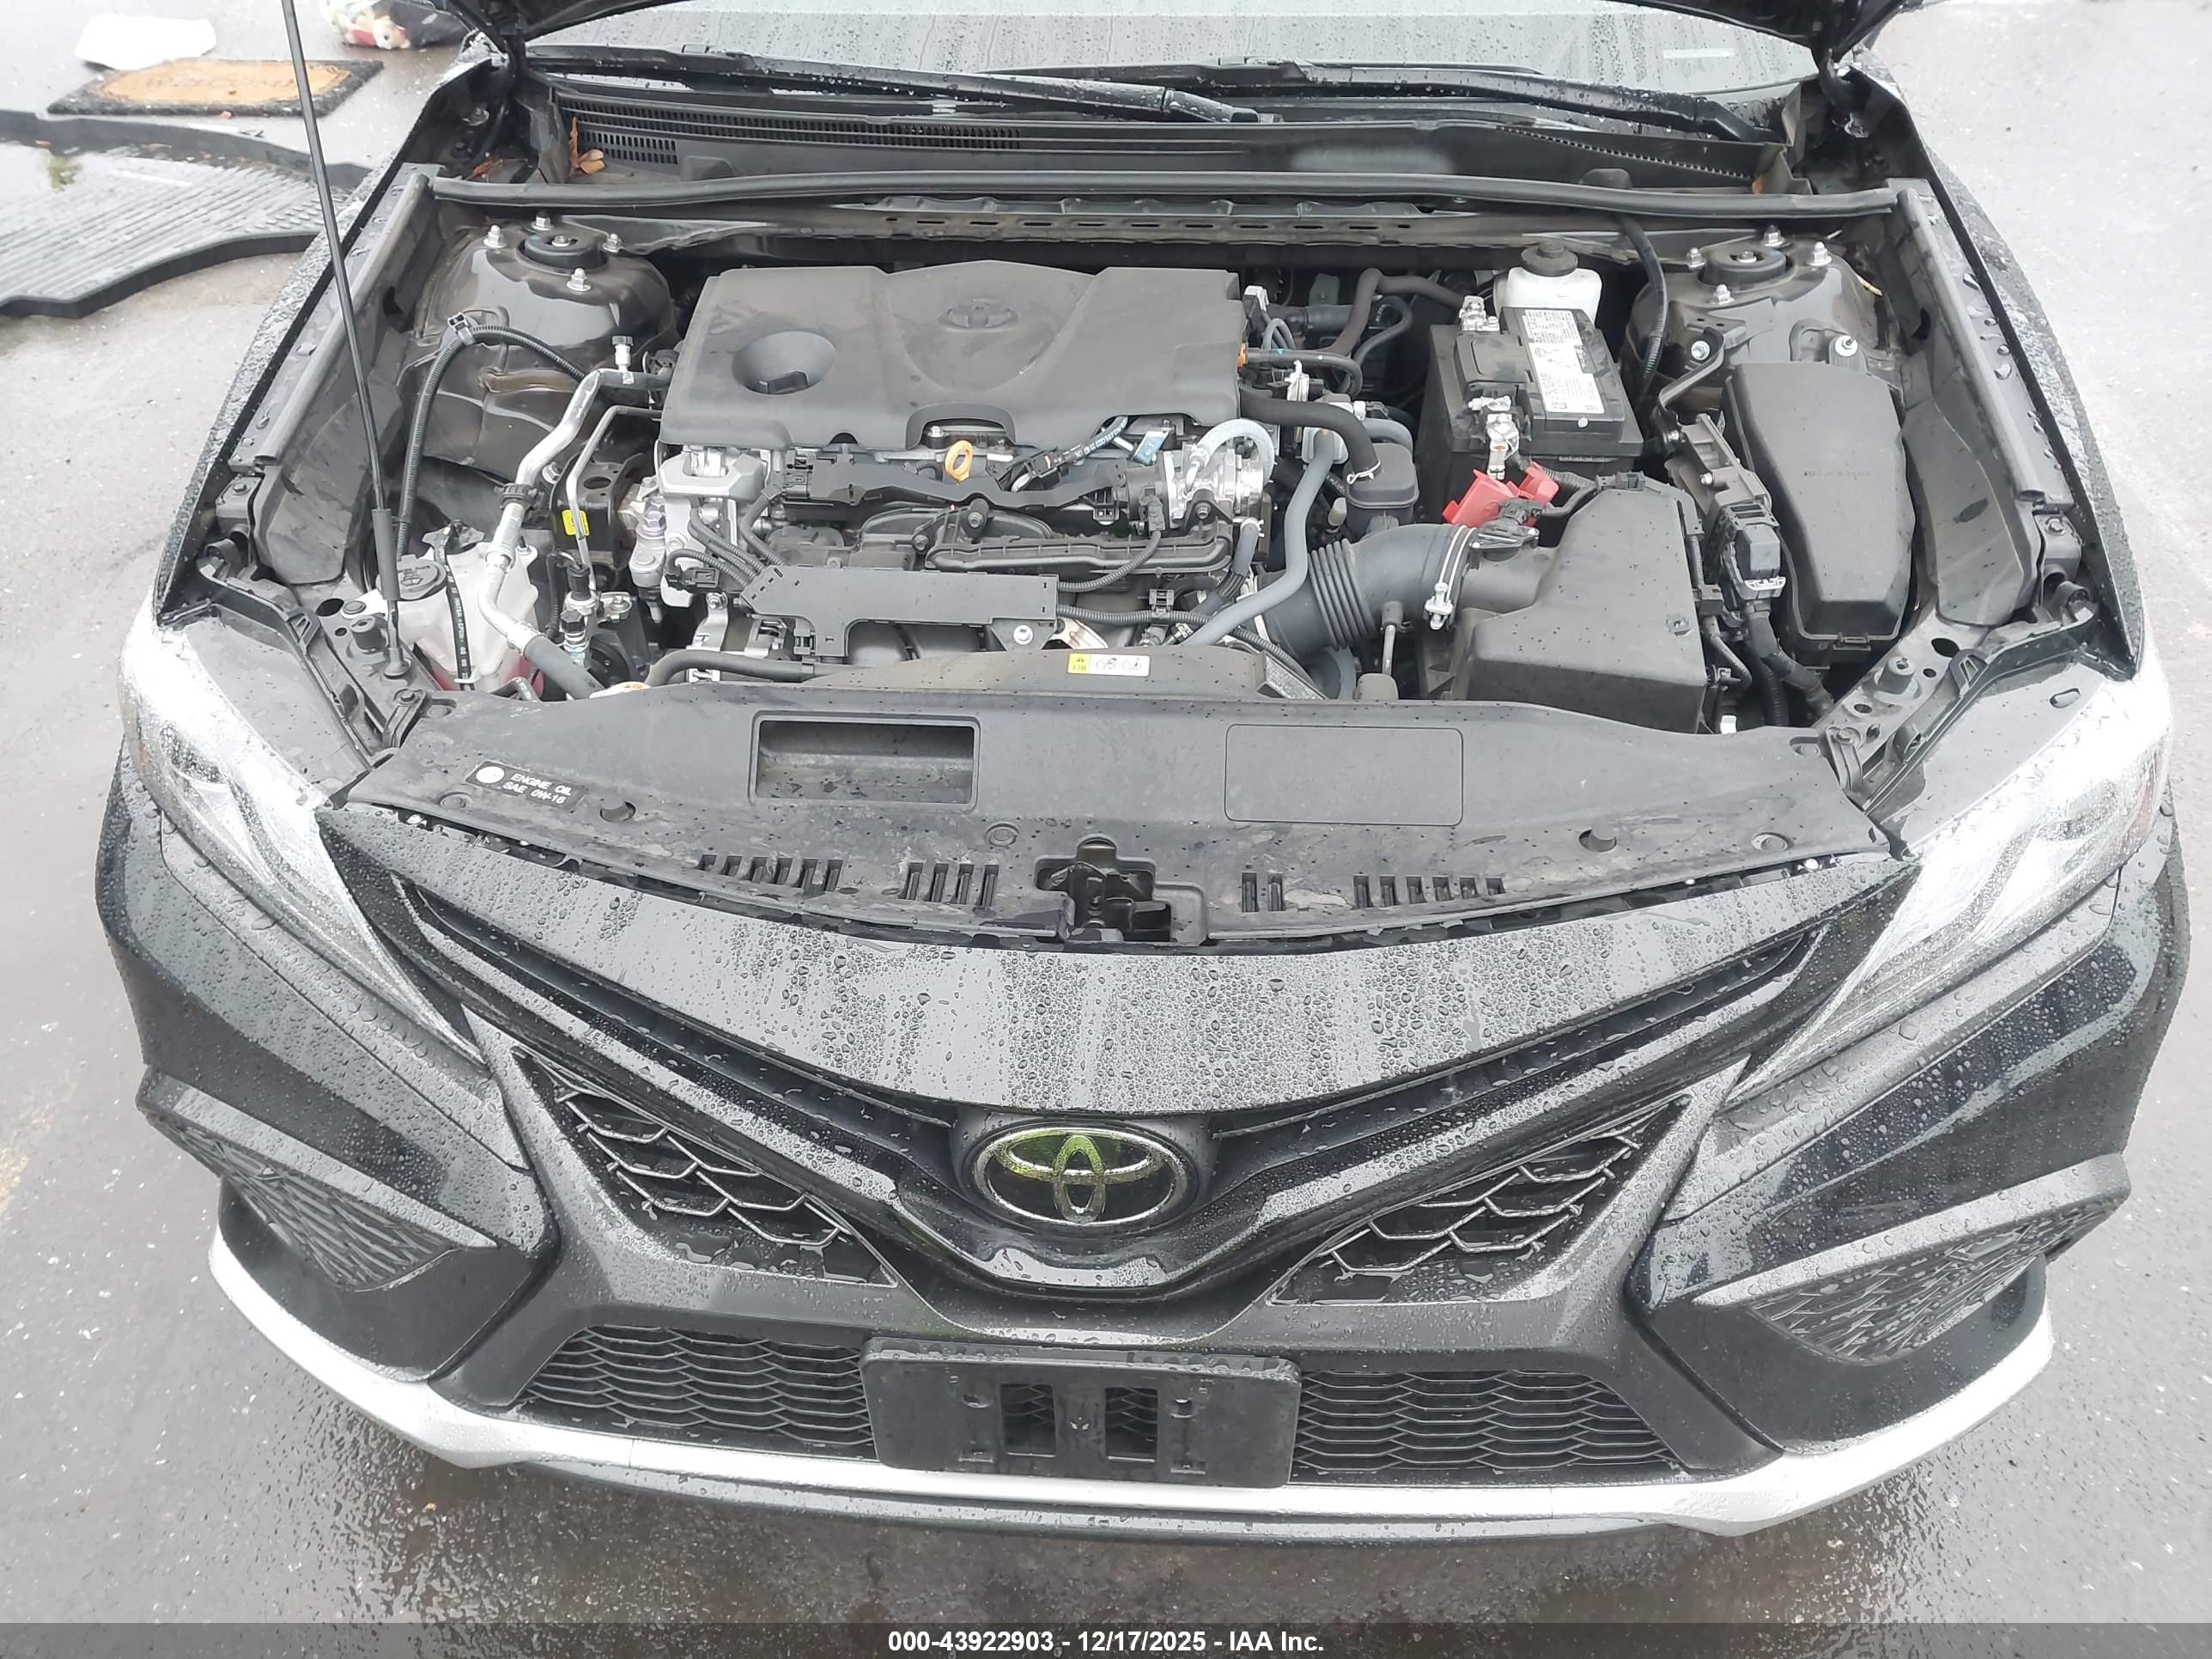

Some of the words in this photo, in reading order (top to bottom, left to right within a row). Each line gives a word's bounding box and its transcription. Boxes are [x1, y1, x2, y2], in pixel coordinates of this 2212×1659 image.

[502, 781, 527, 793] SAE
[531, 789, 567, 805] 0W-16
[511, 773, 551, 790] ENGINE
[555, 785, 572, 796] OIL
